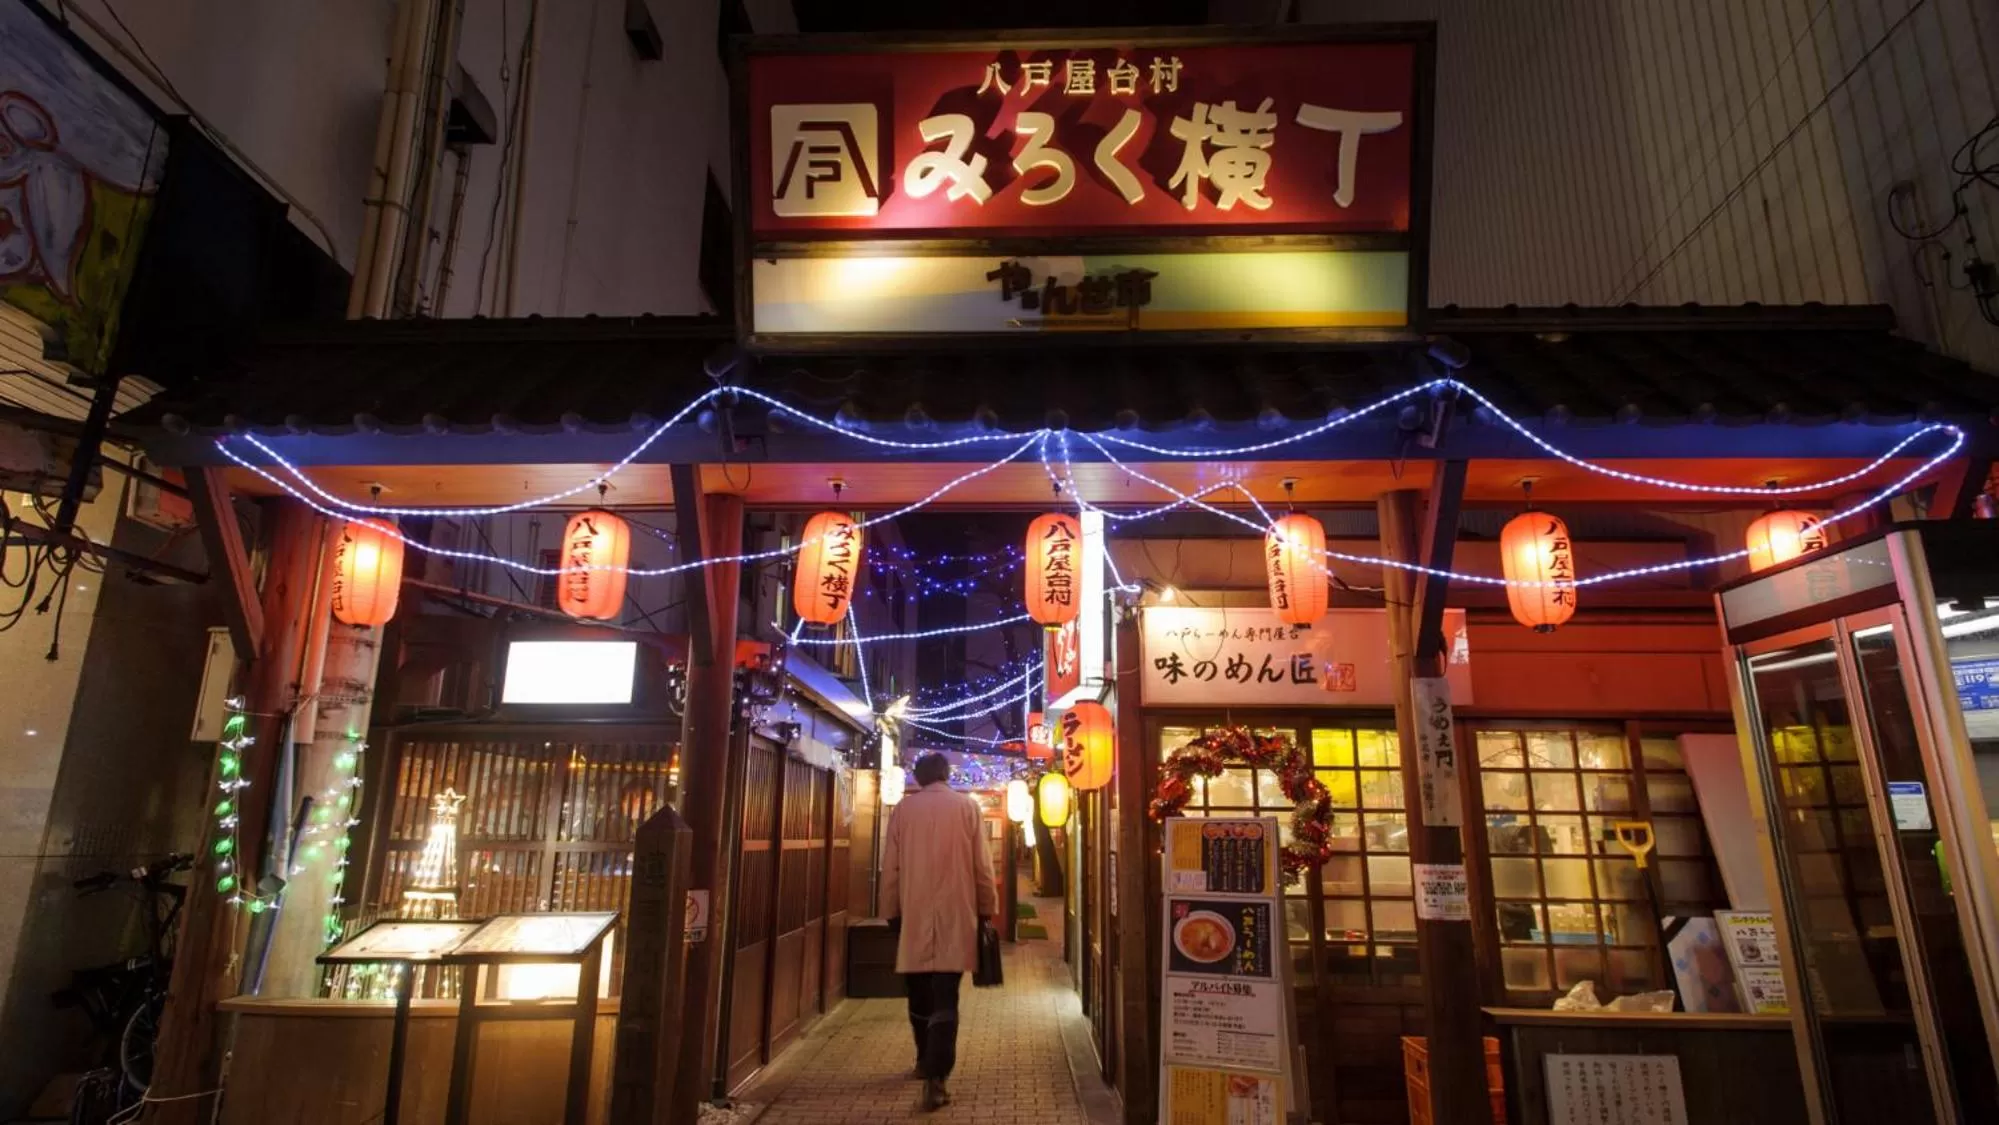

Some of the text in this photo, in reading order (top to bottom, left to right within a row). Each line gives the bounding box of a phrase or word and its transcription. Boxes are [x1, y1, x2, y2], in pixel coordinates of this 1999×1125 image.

[976, 57, 1184, 97] 八戸屋台村
[904, 96, 1403, 210] みろく横丁
[820, 523, 855, 609] みろく横丁
[1044, 521, 1075, 606] 八戸屋台村
[1154, 652, 1318, 685] 味のめん匠
[1063, 711, 1085, 778] ラーメン
